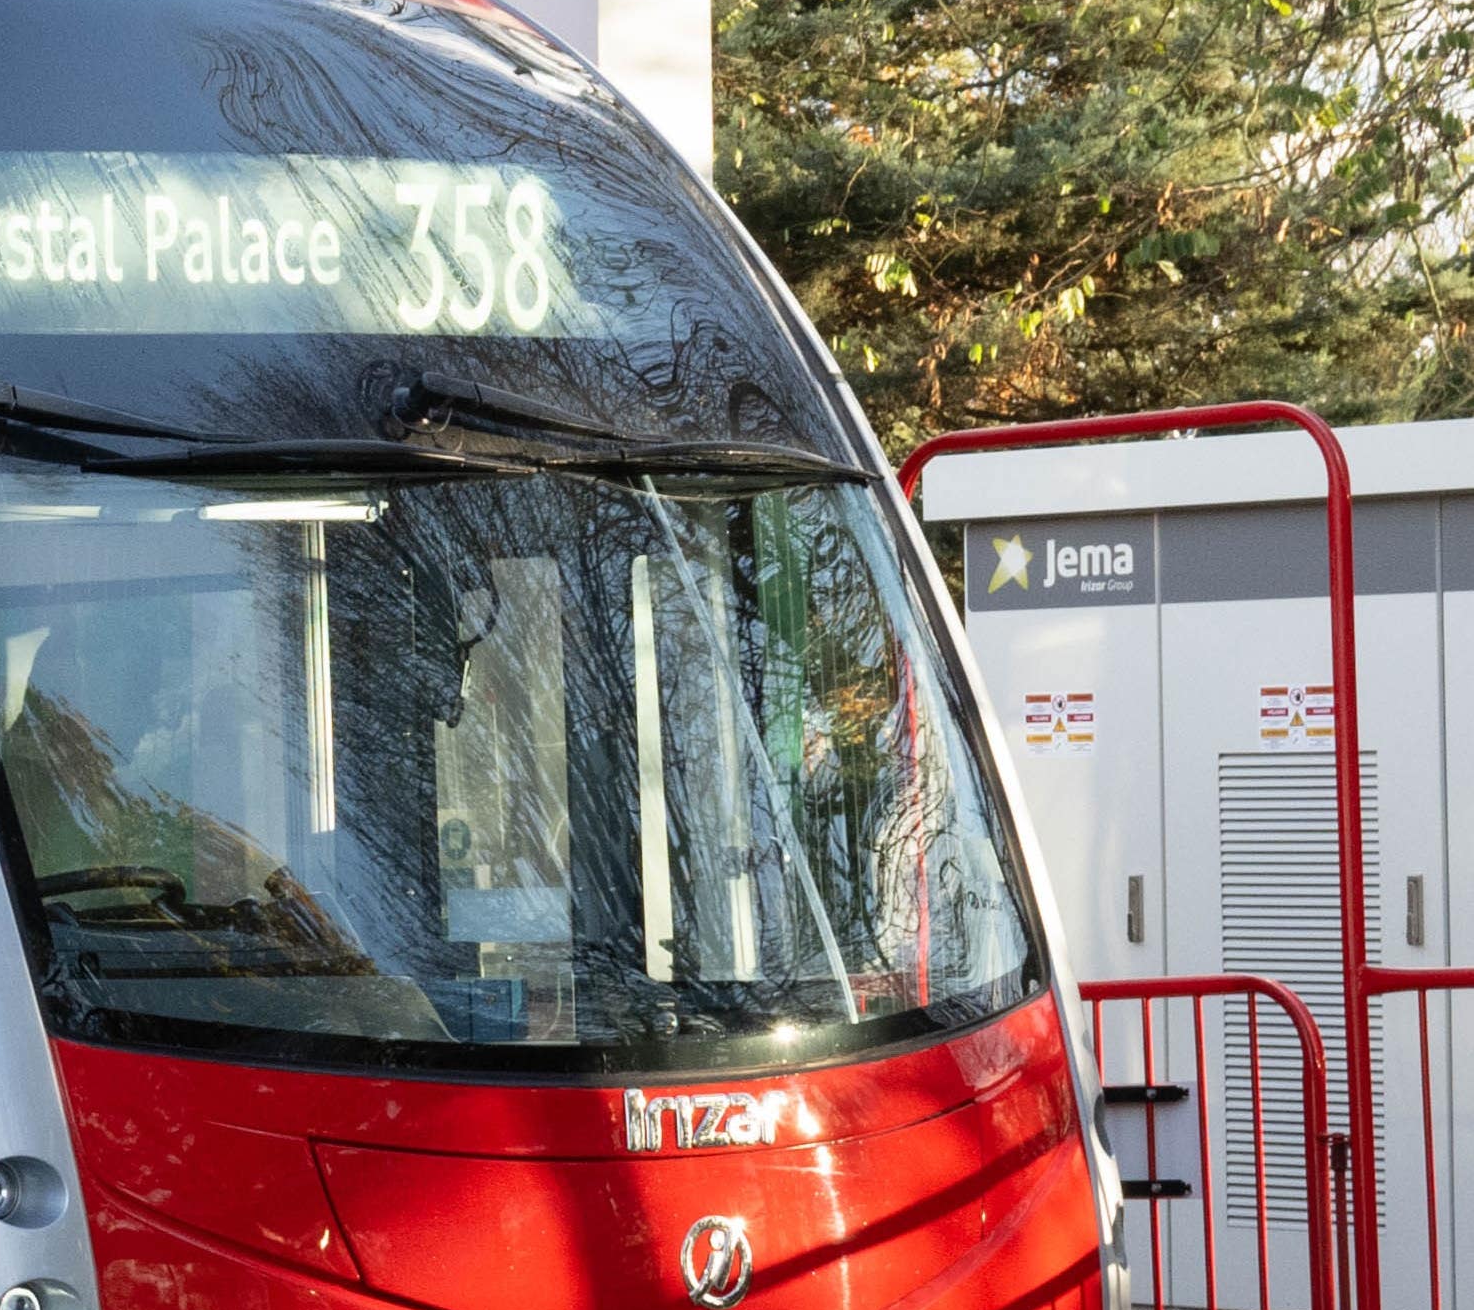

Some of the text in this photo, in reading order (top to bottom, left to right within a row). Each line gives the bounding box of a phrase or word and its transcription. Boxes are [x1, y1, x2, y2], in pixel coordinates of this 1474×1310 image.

[145, 194, 342, 287] Palace
[394, 180, 552, 333] 358
[1043, 538, 1133, 589] Jema
[624, 1088, 787, 1153] Irizar
